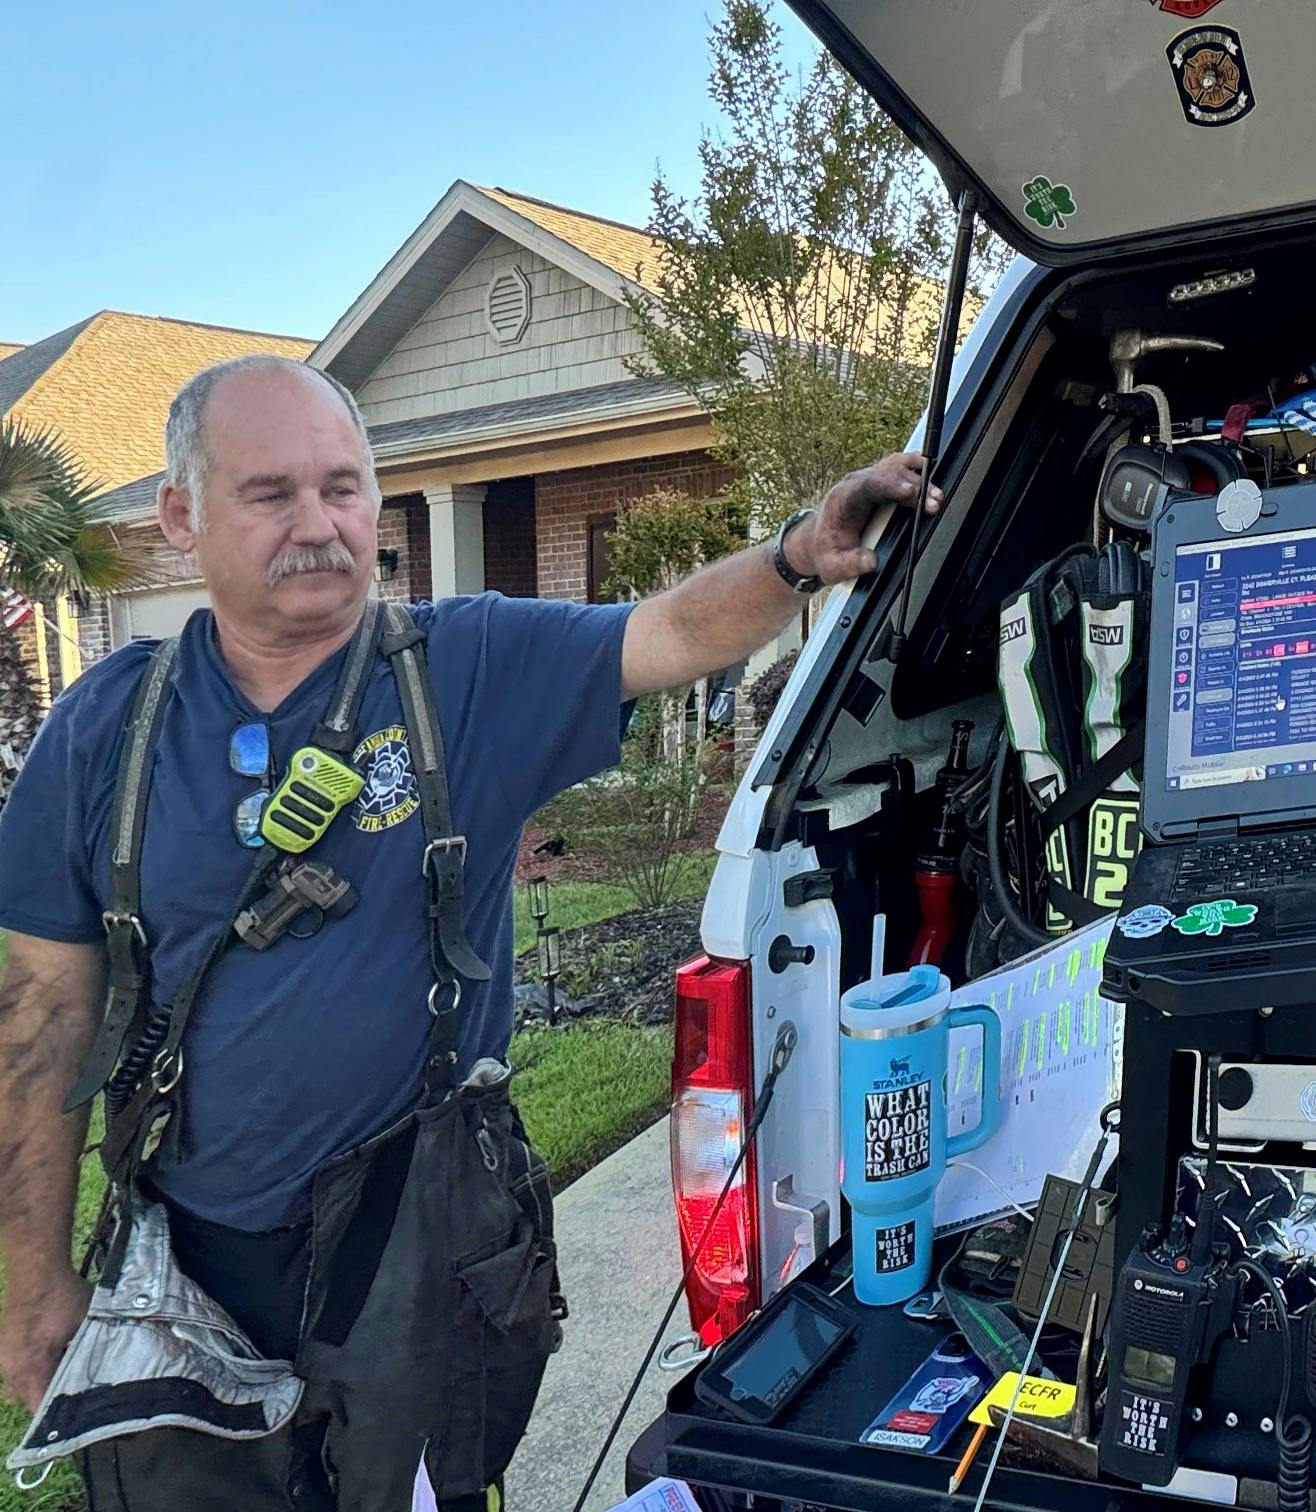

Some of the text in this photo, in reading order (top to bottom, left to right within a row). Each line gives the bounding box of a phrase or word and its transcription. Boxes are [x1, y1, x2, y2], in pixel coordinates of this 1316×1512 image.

[1090, 627, 1121, 643] MSA
[1094, 811, 1138, 858] BC
[1093, 861, 1128, 907] 2
[873, 1072, 923, 1090] STANLEY
[866, 1082, 929, 1119] WHAT
[866, 1108, 929, 1142] COLOR
[866, 1128, 929, 1164] IS THE
[866, 1150, 929, 1177] TRASH CAN
[885, 1225, 907, 1240] IT'S
[878, 1233, 914, 1251] WORTH
[882, 1254, 909, 1269] RISK
[886, 1246, 906, 1259] THE
[1144, 1284, 1184, 1298] MOTOROLA
[1020, 1381, 1062, 1401] ECFR
[1132, 1396, 1161, 1414] IT'S
[1122, 1406, 1169, 1429] WORTH
[873, 1431, 926, 1447] ISAKSON
[1130, 1421, 1155, 1439] THE
[1123, 1431, 1157, 1452] RISK
